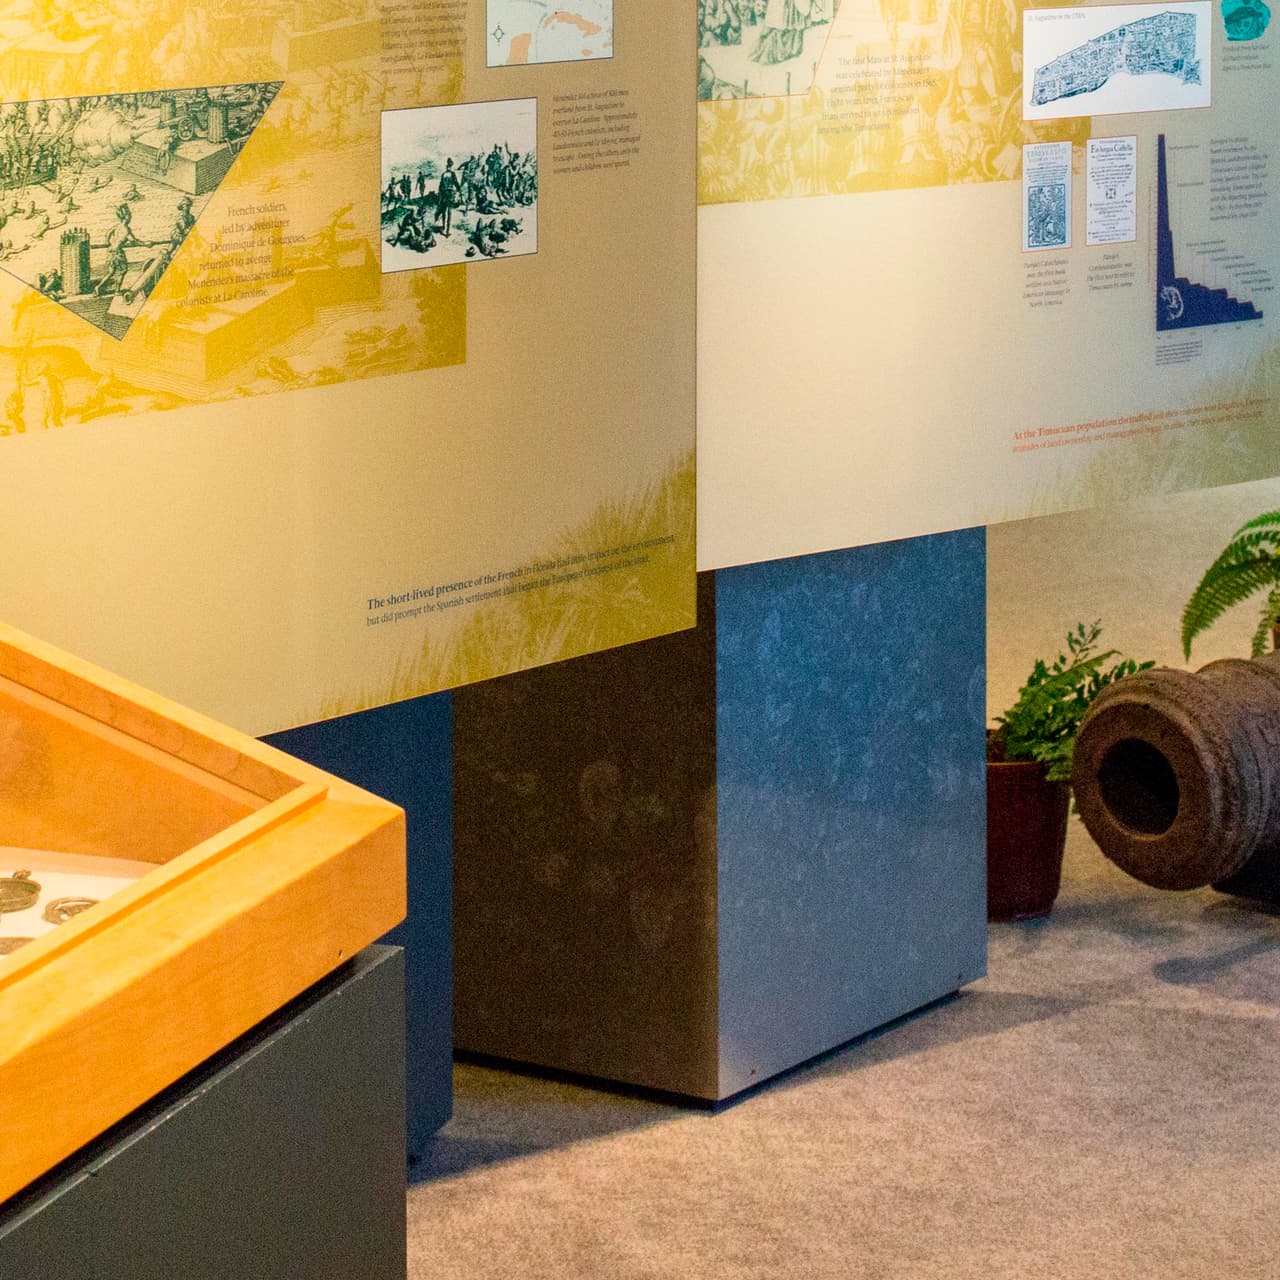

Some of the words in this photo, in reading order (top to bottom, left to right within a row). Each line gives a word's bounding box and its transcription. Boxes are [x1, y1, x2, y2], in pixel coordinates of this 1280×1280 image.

[367, 598, 385, 610] The
[386, 585, 434, 606] short-lived
[435, 580, 474, 598] presence
[474, 575, 483, 586] of
[483, 573, 496, 584] the
[496, 566, 521, 581] French
[394, 604, 422, 623] prompt
[422, 602, 436, 613] the
[436, 595, 464, 613] Spanish
